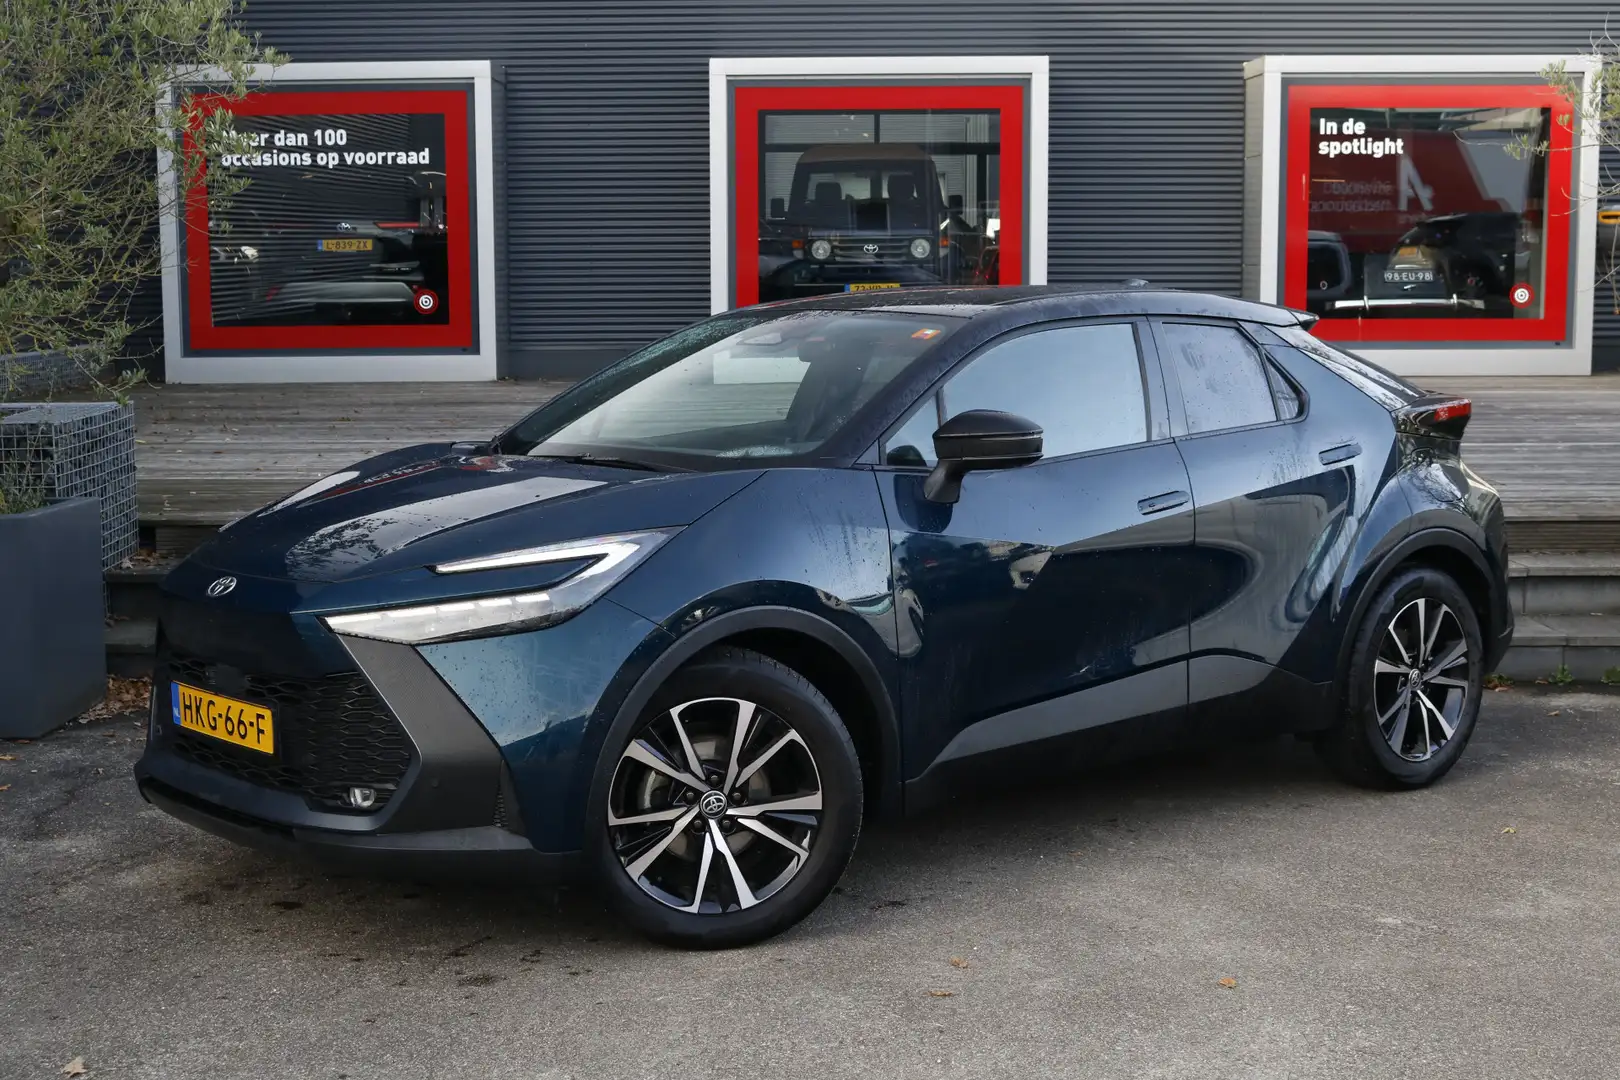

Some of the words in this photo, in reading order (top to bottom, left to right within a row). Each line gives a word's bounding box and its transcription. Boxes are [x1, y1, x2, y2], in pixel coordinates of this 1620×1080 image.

[1319, 117, 1338, 135] In
[1341, 117, 1366, 135] de
[273, 129, 308, 146] dan
[313, 129, 347, 146] 100
[1318, 137, 1404, 158] spotlight
[221, 149, 312, 166] occasions
[316, 152, 339, 169] op
[342, 147, 430, 165] voorraad
[182, 691, 266, 744] HKG-66-F
